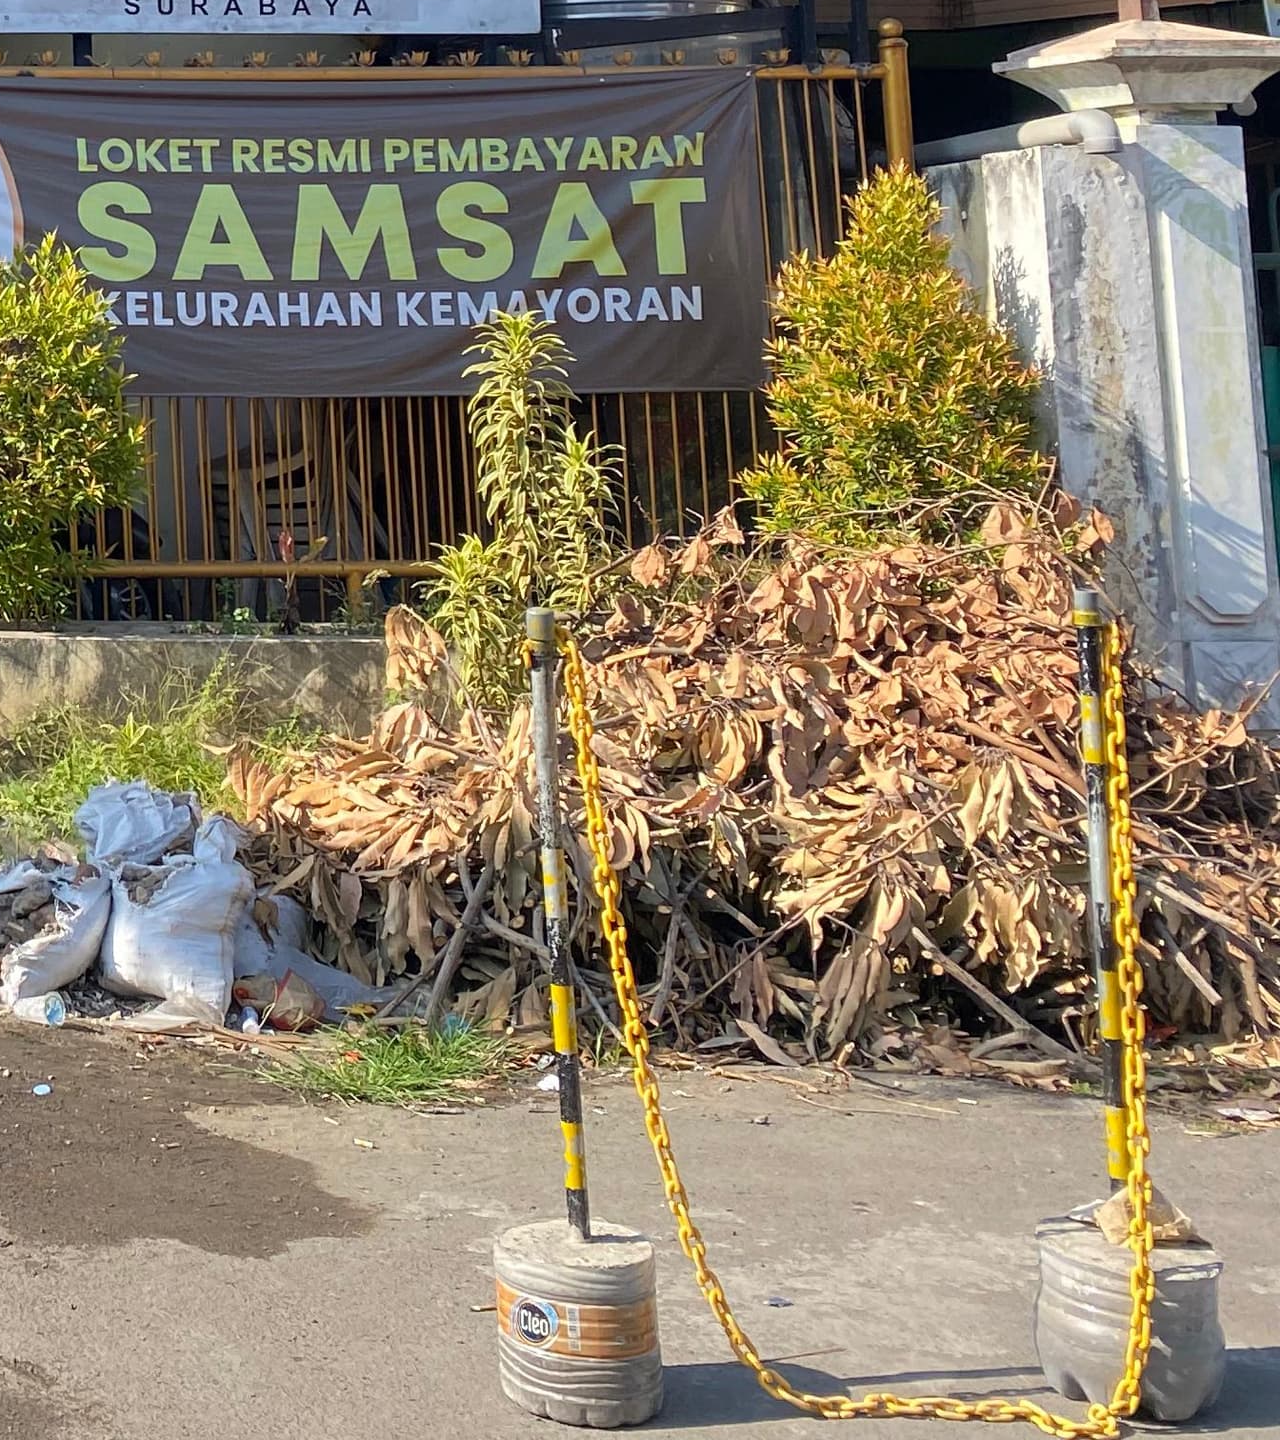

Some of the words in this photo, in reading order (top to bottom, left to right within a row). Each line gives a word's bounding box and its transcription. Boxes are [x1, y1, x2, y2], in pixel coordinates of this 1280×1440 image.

[76, 138, 220, 173] LOKET
[233, 138, 371, 173] RESMI
[385, 131, 706, 173] PEMBAYARAN
[76, 176, 708, 283] SAMSAT
[396, 285, 703, 327] KEMAYORAN
